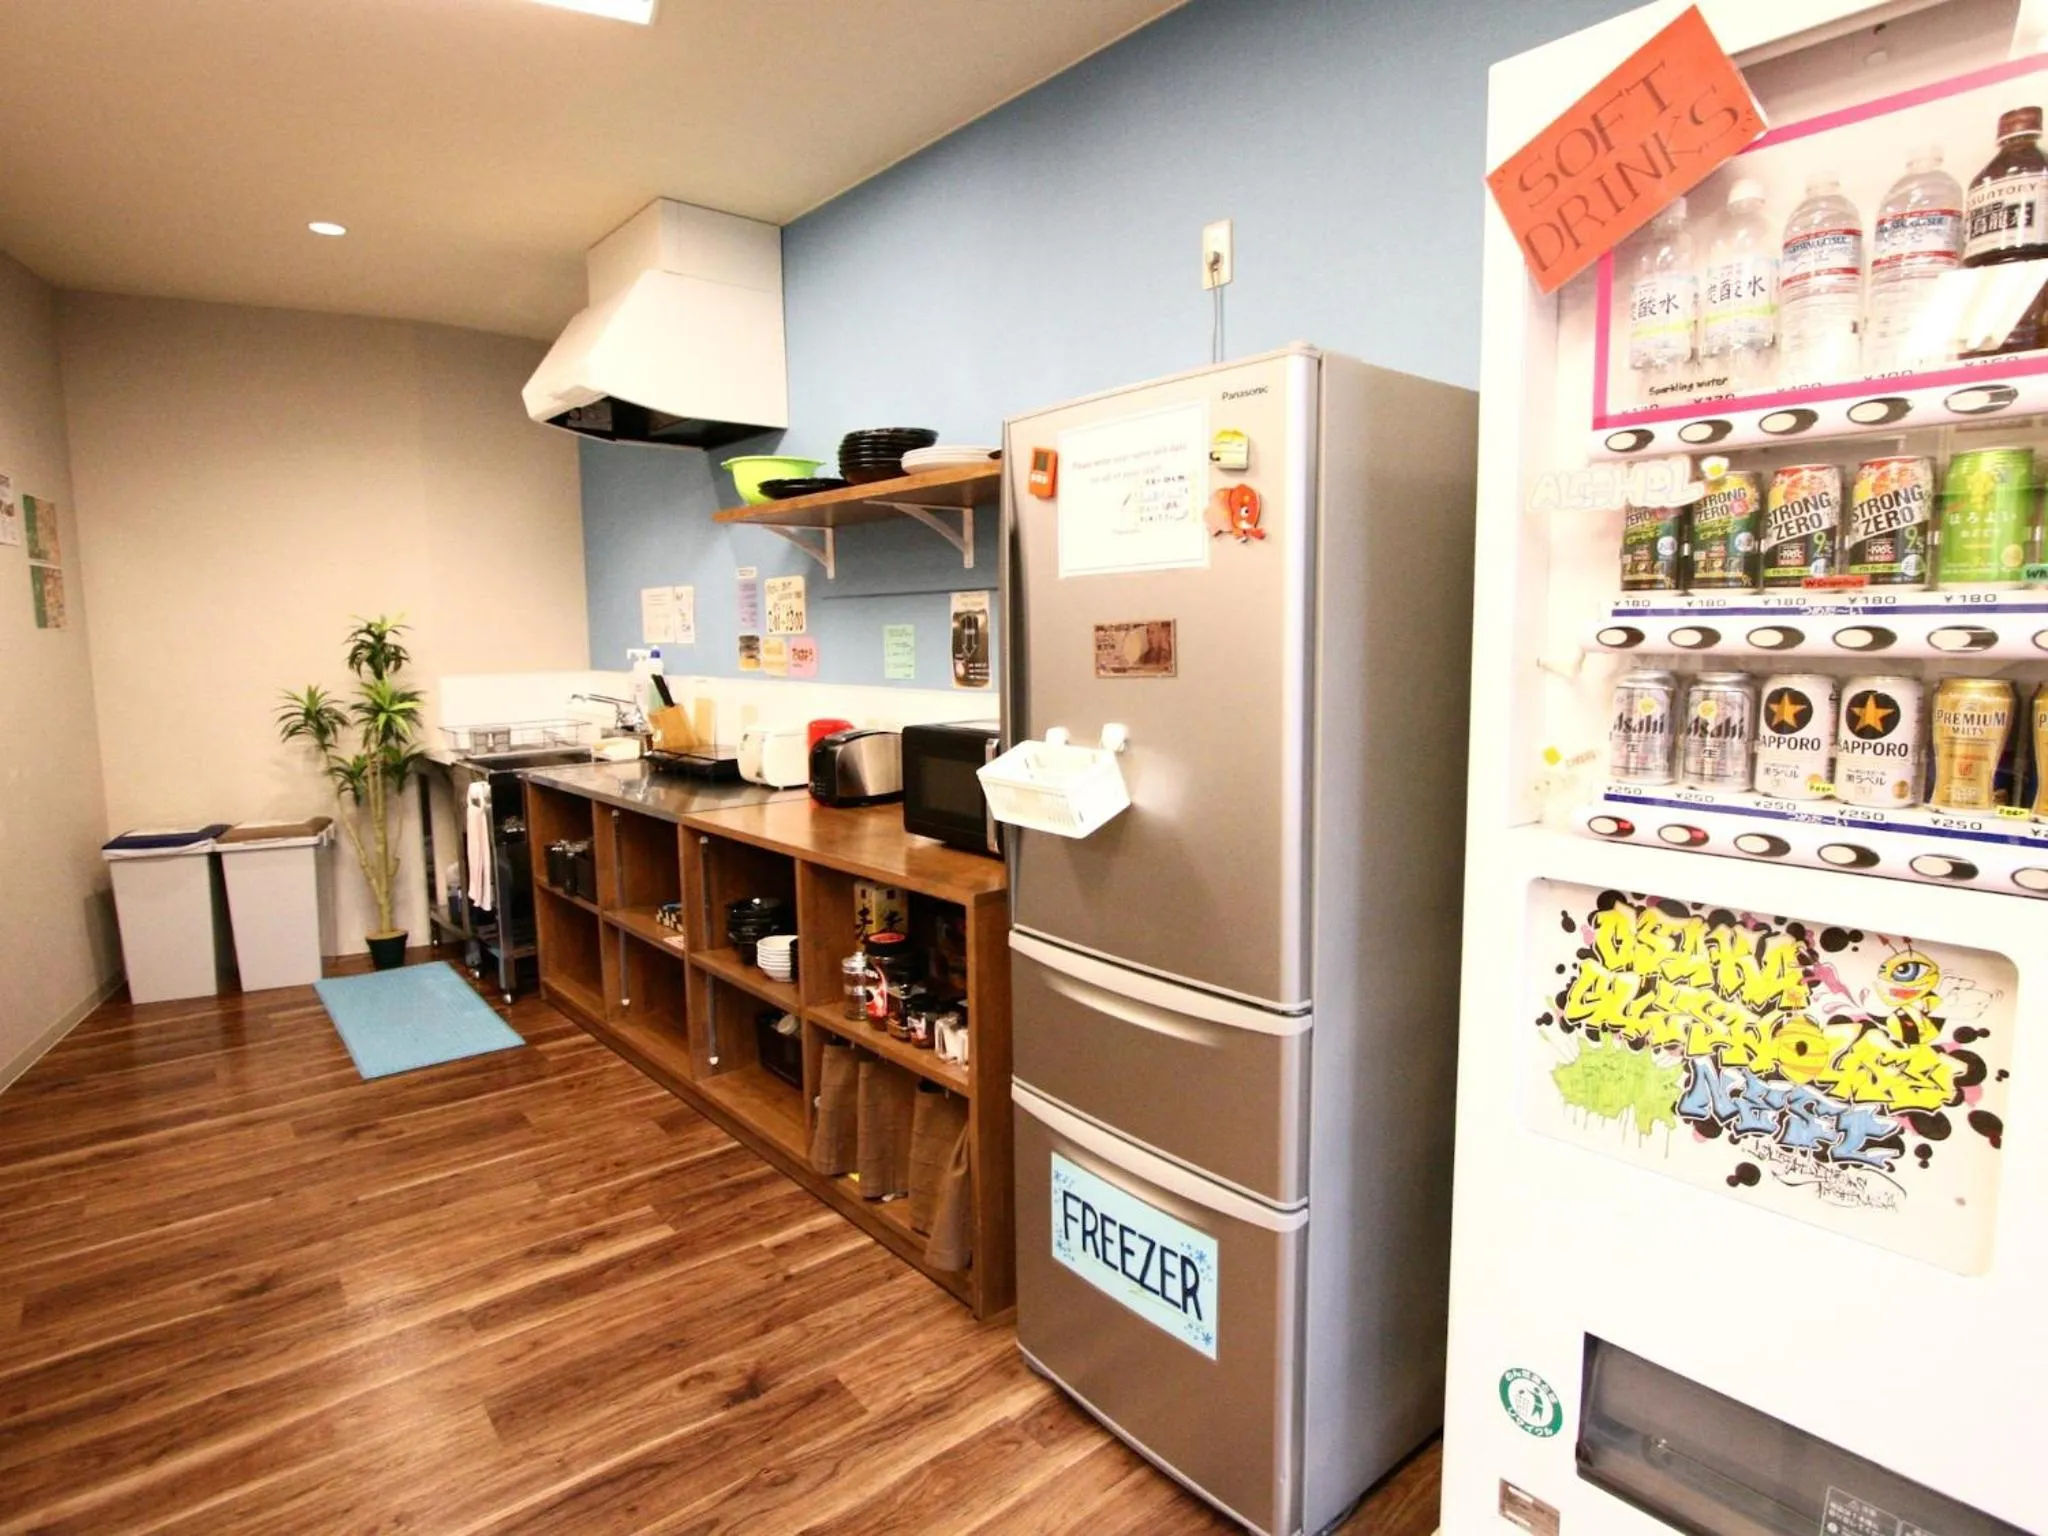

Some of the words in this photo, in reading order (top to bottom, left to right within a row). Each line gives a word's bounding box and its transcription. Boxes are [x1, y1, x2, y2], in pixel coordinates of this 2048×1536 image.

[1517, 61, 1671, 209] SOFT
[1524, 86, 1740, 273] DRINKS
[1222, 385, 1269, 401] Panasonic
[1649, 382, 1694, 396] Sparkling
[1767, 491, 1832, 528] STRONG
[1852, 485, 1924, 522] STRONG
[1697, 503, 1729, 522] ZERO
[1774, 513, 1823, 541] ZERO
[1862, 506, 1915, 536] ZERO
[1613, 600, 1650, 608] ¥180
[1687, 599, 1727, 607] ¥180
[1762, 598, 1807, 606] ¥180
[1848, 596, 1897, 605] ¥180
[1944, 594, 1996, 603] ¥180
[1613, 712, 1665, 734] Asahi
[1935, 709, 2006, 728] PREMIUM
[1686, 716, 1744, 740] Asahi
[1759, 736, 1821, 752] APPORO
[1846, 774, 1886, 786] 黒ラベル
[1607, 785, 1642, 796] ¥250
[1675, 792, 1715, 803] ¥250
[1753, 801, 1797, 811] ¥250
[1838, 808, 1885, 822] ¥250
[1930, 817, 1982, 831] ¥250
[1062, 1190, 1203, 1321] FREEZER
